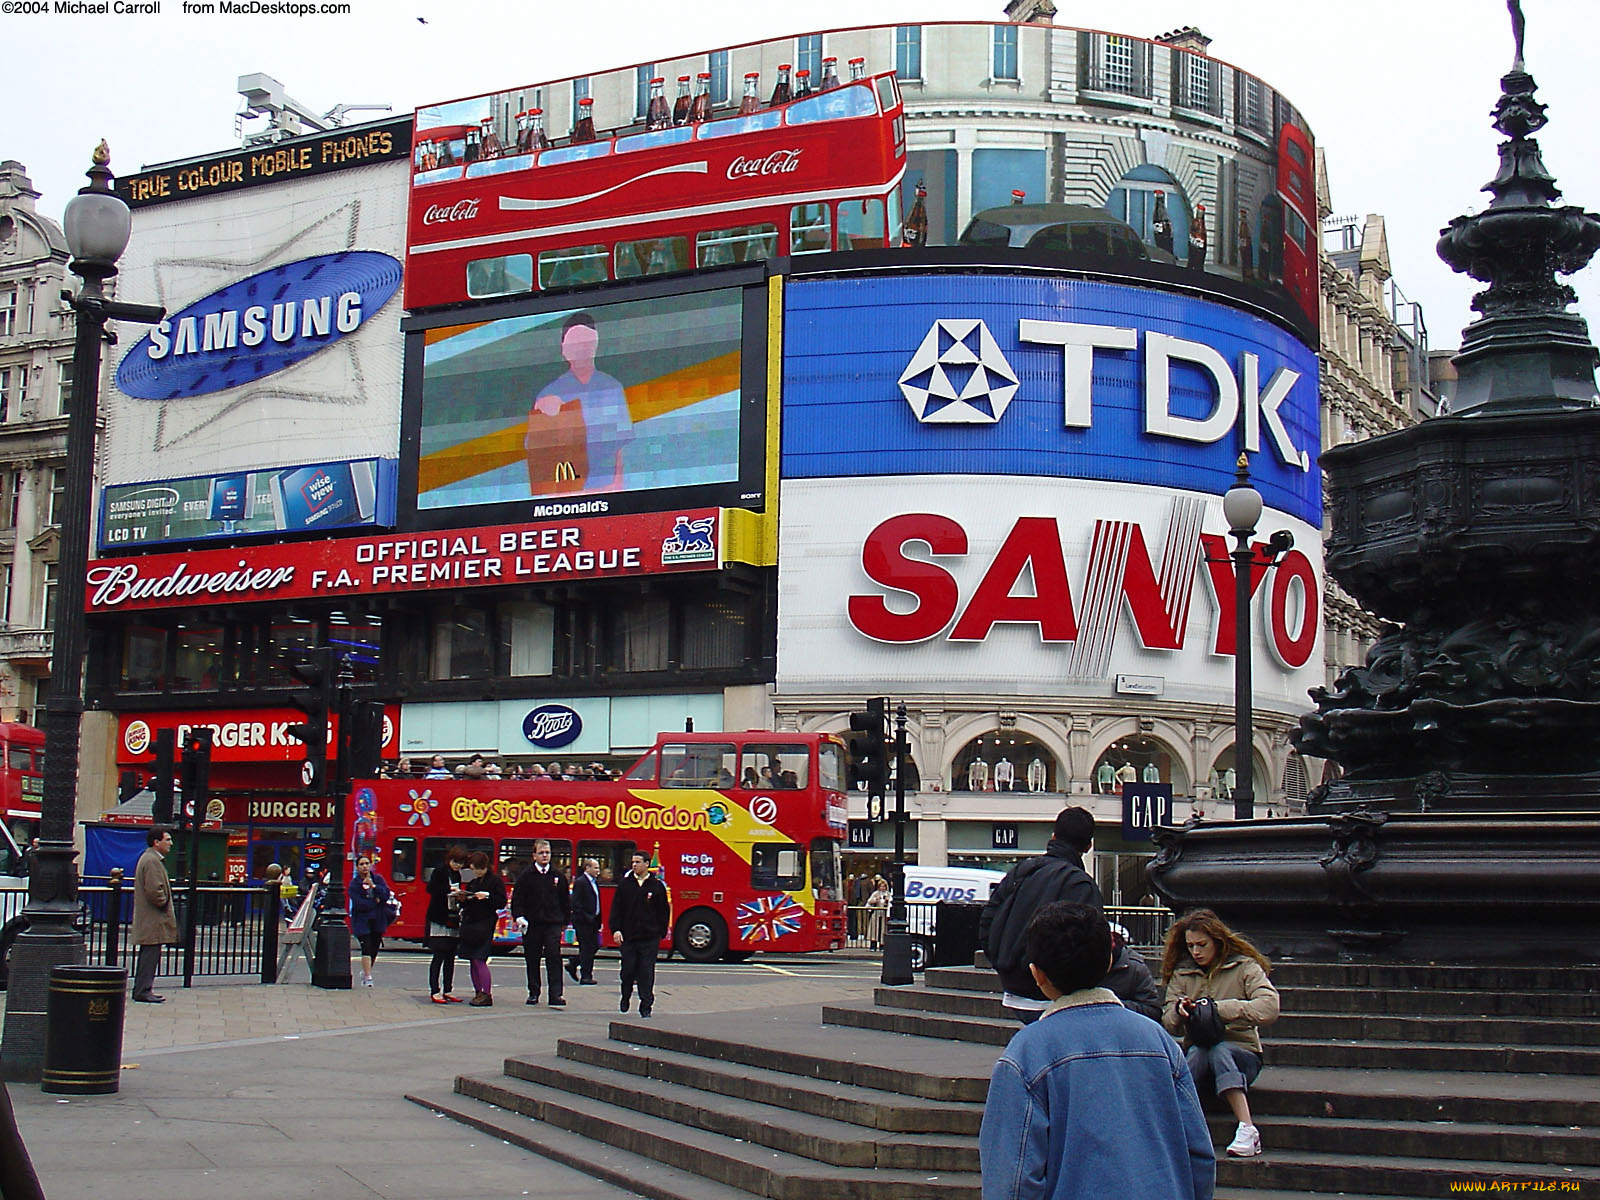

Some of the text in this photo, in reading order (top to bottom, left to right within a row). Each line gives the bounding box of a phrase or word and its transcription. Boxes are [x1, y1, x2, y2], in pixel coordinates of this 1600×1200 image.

[128, 131, 393, 201] TRUE COLOUR MOBILE PHONES
[725, 148, 804, 181] Coca-Cola
[422, 197, 482, 226] Coca-Cola
[147, 291, 363, 361] SAMSUNG
[308, 475, 332, 493] wise
[109, 499, 146, 513] SAMSUNG
[740, 492, 762, 500] SONY
[533, 499, 609, 518] McDonald's
[107, 528, 129, 543] LCD
[133, 526, 147, 540] TV
[355, 527, 581, 564] OFFICIAL BEER
[311, 547, 641, 589] F.A. PREMIER LEAGUE
[86, 560, 296, 607] Budweiser
[847, 500, 1320, 677] SANYO
[527, 711, 573, 740] Boots
[128, 732, 146, 745] KING
[248, 801, 321, 818] BURGER
[615, 800, 709, 832] London
[1131, 795, 1166, 829] GAP
[852, 827, 871, 843] GAP
[995, 829, 1015, 844] GAP
[229, 864, 246, 873] 100
[681, 853, 713, 865] Hop On
[681, 865, 715, 877] Hop Off
[905, 880, 977, 901] BONDS
